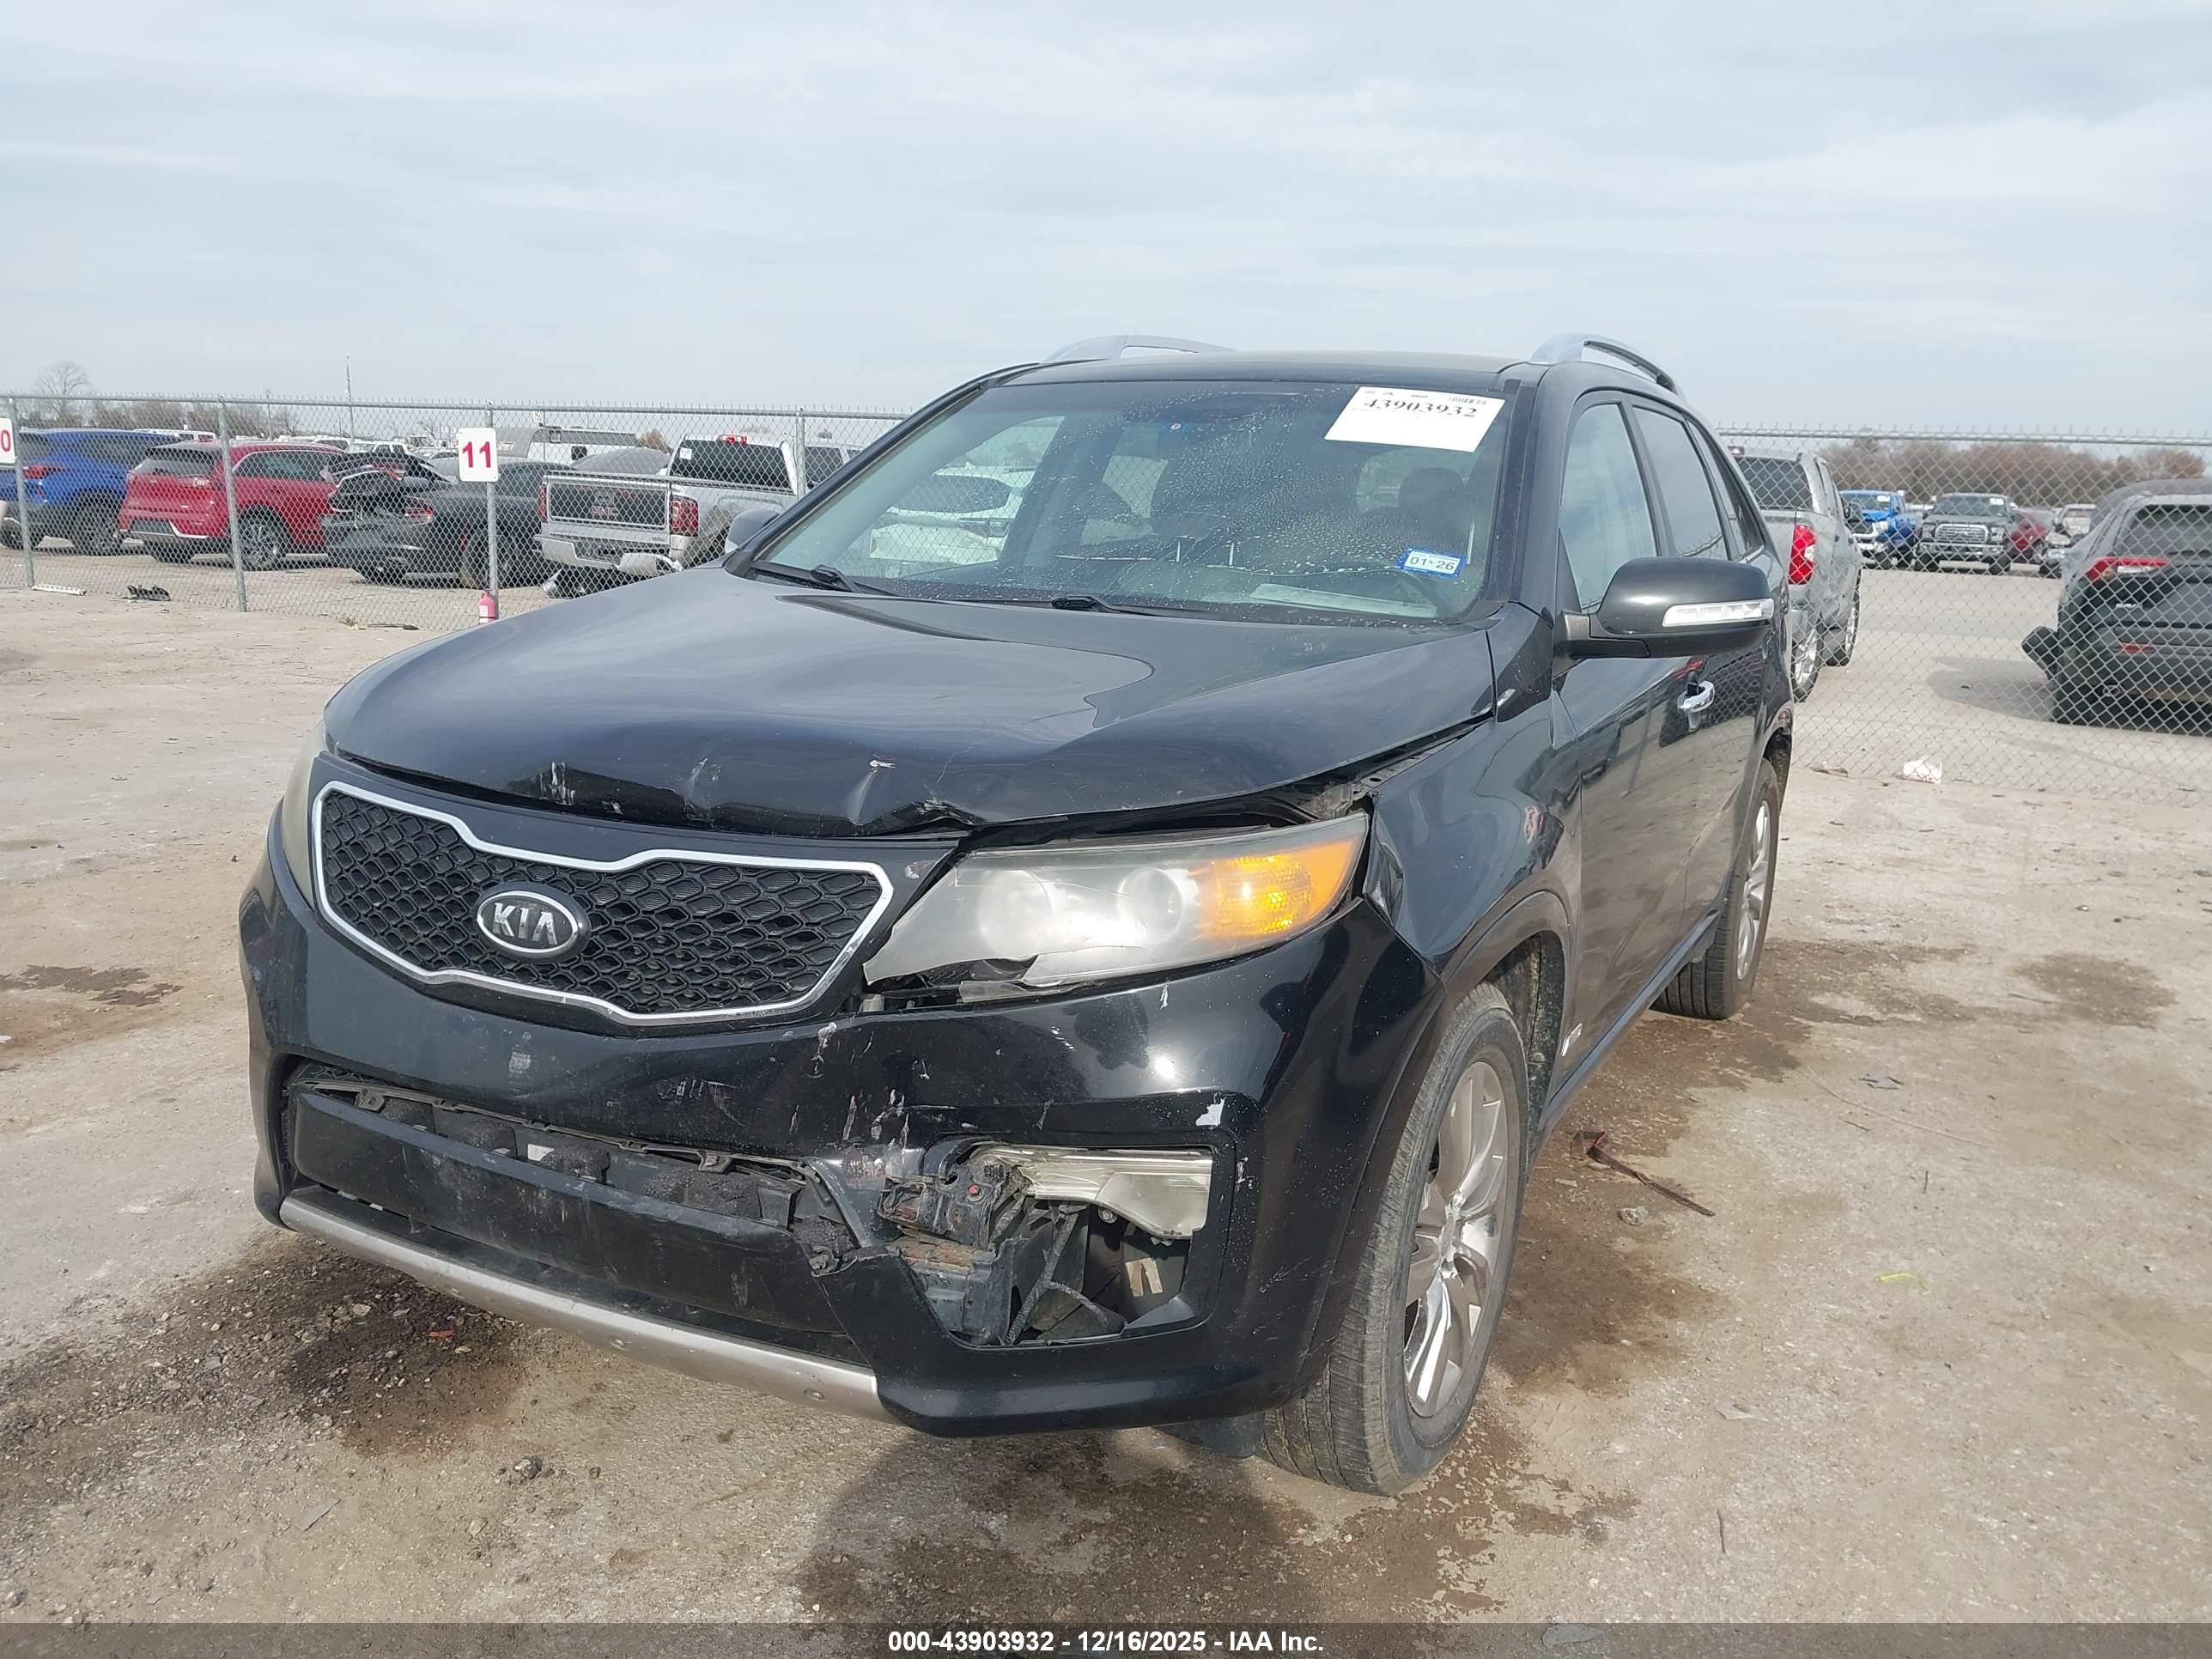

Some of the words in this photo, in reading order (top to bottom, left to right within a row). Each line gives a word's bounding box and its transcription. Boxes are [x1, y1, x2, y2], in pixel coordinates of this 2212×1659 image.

[1364, 398, 1477, 417] 43903932
[462, 441, 491, 468] 11
[1409, 556, 1427, 566] 01
[1435, 561, 1455, 571] 26
[492, 902, 558, 945] KIA
